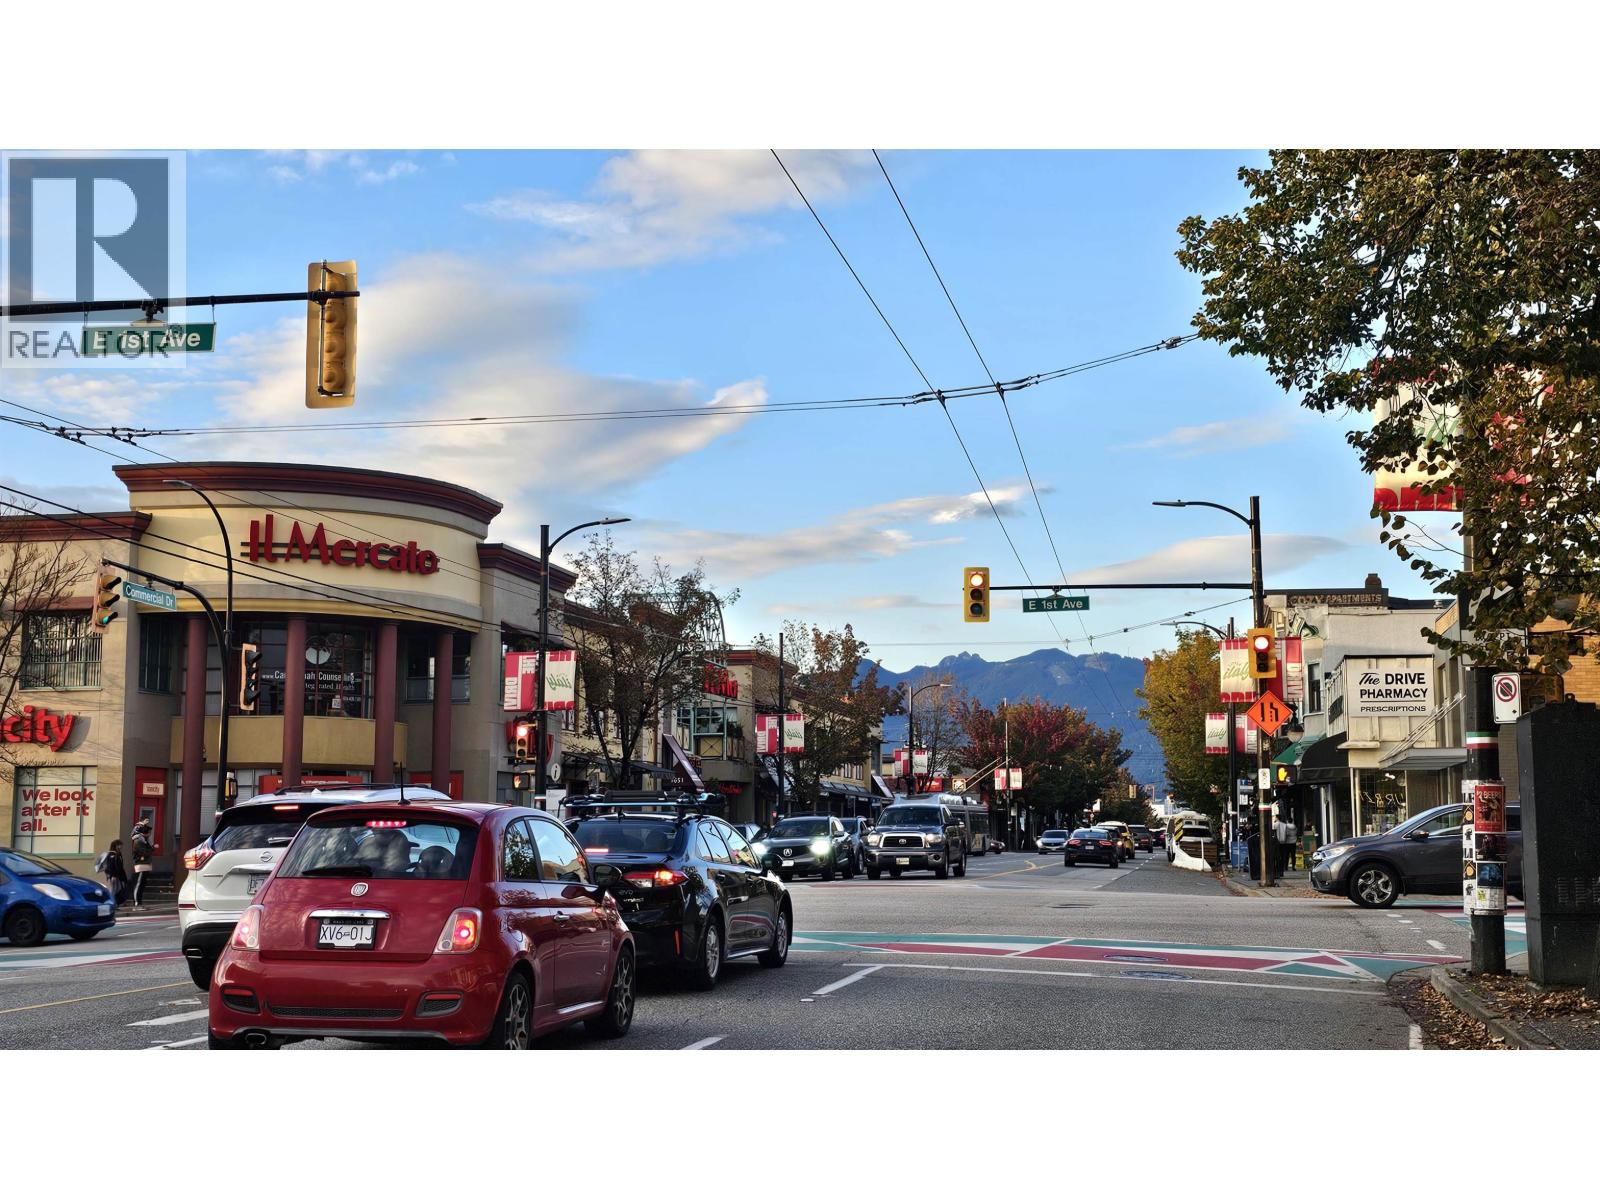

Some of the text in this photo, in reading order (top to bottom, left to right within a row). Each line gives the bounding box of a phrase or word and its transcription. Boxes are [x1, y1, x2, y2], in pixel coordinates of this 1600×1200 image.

[93, 330, 201, 349] E 1st Ave
[250, 514, 438, 575] Il Mercato
[126, 585, 174, 607] Commercial Dr
[1029, 599, 1083, 610] E 1st Ave
[1359, 672, 1426, 685] The DRIVE
[1360, 688, 1428, 699] PHARMACY
[0, 705, 74, 752] city
[22, 788, 94, 801] We look
[21, 802, 89, 817] after it
[20, 819, 47, 832] all.
